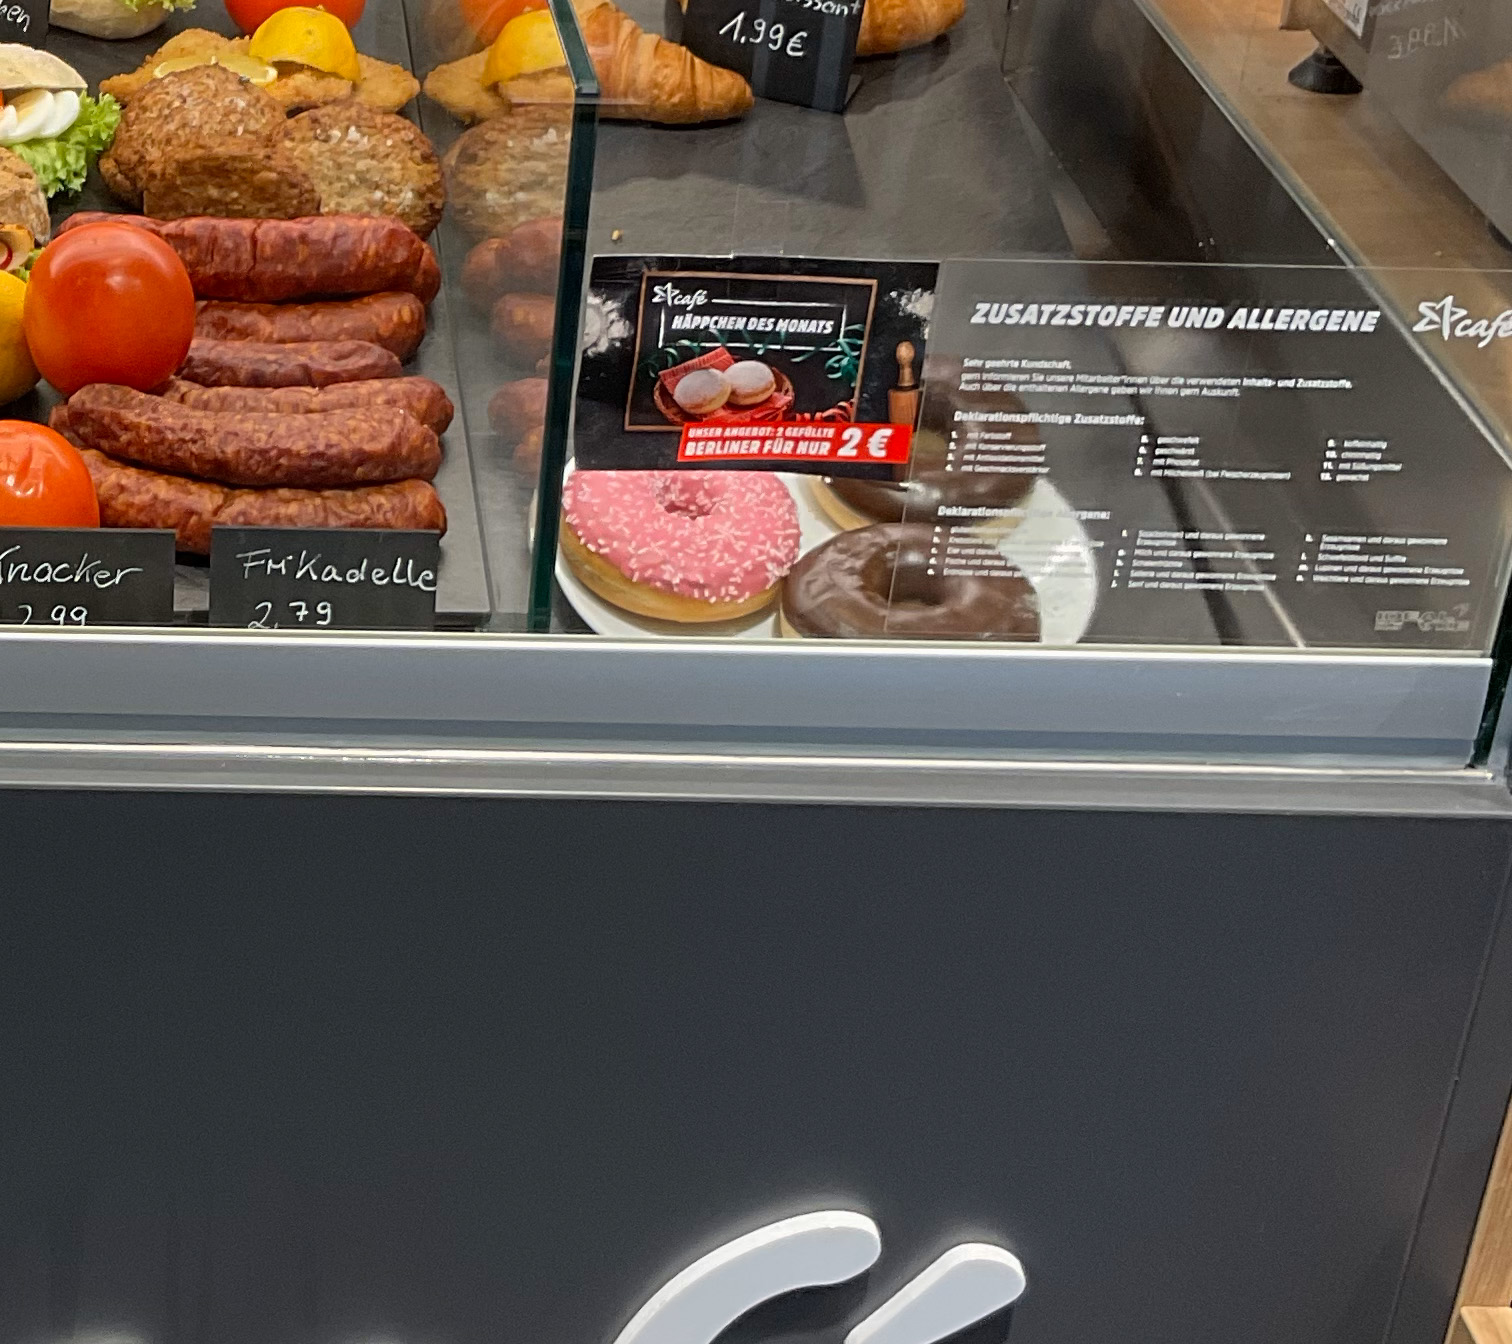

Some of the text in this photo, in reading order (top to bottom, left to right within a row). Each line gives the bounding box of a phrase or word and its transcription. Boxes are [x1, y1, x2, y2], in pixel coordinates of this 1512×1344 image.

[673, 289, 709, 311] café
[671, 313, 836, 336] HÄPPCHEN DES MONATS
[969, 302, 1381, 334] ZUSATZSTOFFE UND ALLERGENE
[954, 410, 1145, 426] Deklarationspflichtige Zusatzstoffe:
[688, 427, 722, 439] UNSER
[723, 426, 775, 438] ANGEBOT:
[837, 427, 893, 458] 2 €
[684, 436, 832, 457] BERLINER FÜR NUR
